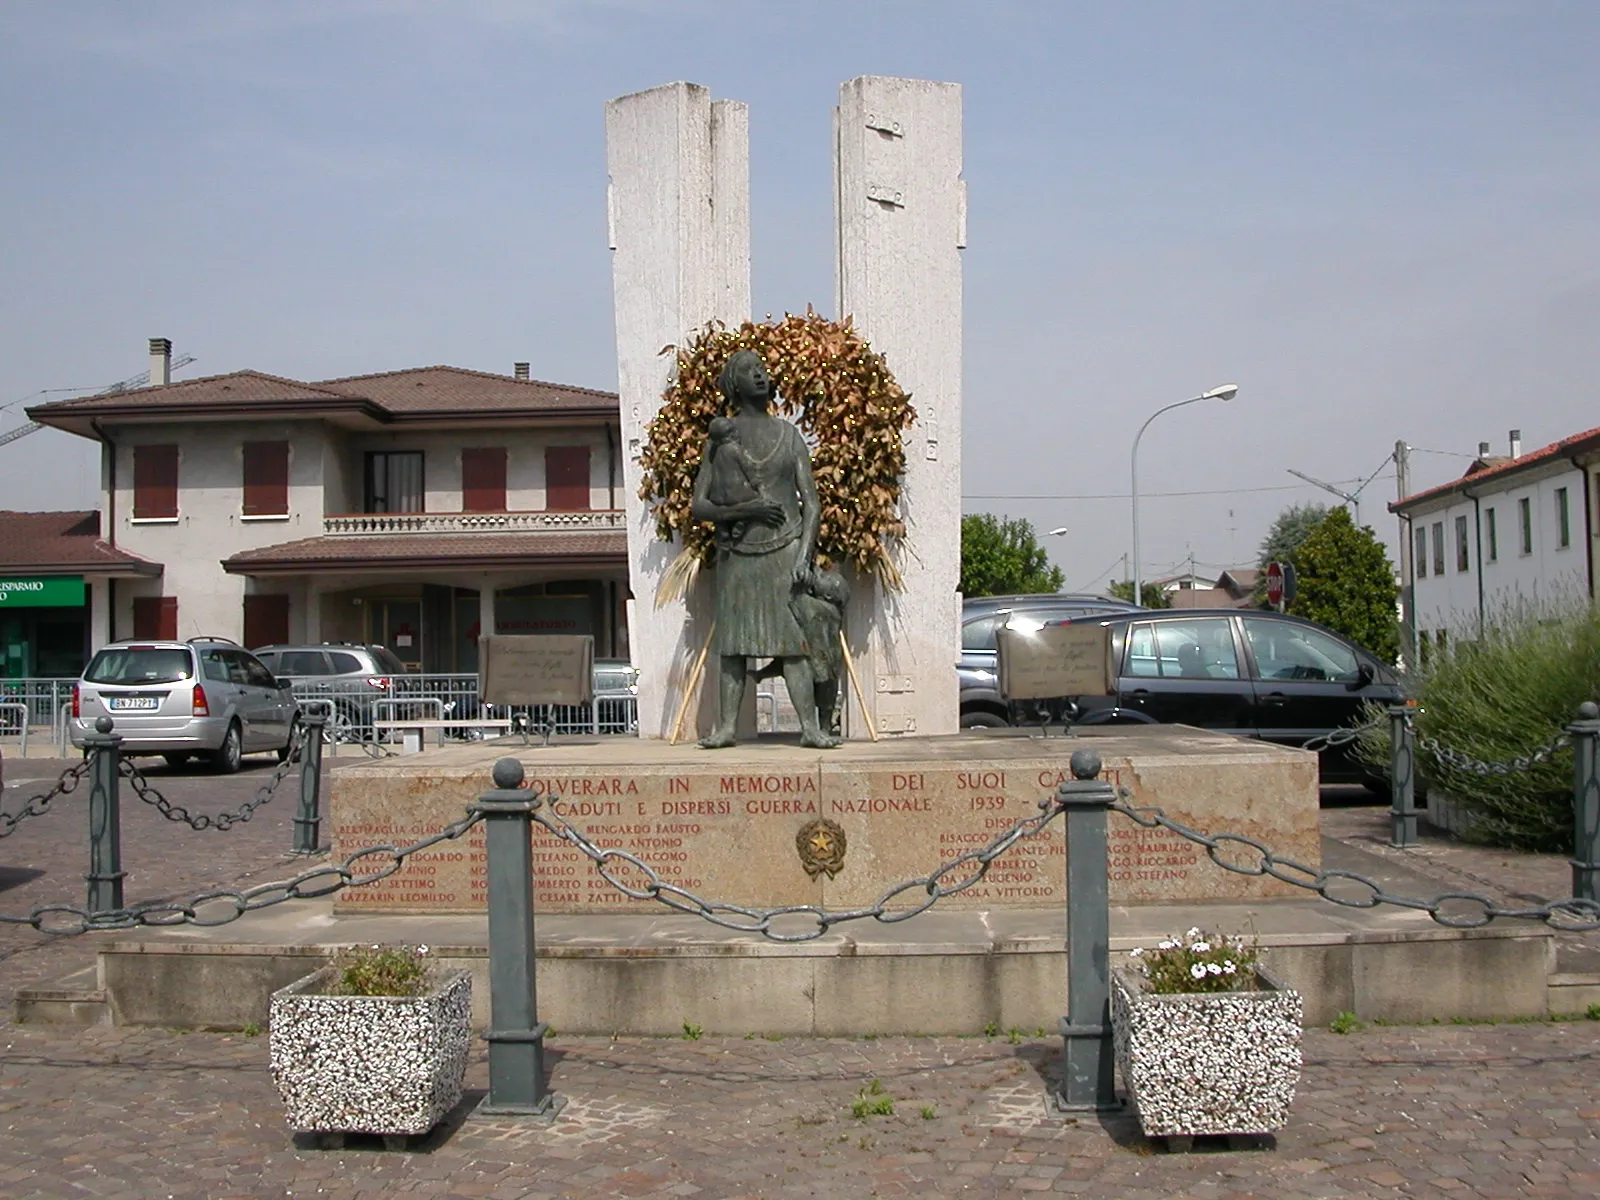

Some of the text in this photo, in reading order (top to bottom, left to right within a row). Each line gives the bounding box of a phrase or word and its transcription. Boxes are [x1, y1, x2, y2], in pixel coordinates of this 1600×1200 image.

[669, 777, 690, 794] IN
[720, 776, 816, 794] MEMORIA
[893, 774, 924, 791] DEI
[957, 772, 1006, 790] SUOI
[1038, 769, 1120, 789] CATI
[555, 802, 621, 816] CADUTI
[638, 802, 645, 815] E
[662, 801, 730, 815] DISPERSI
[746, 800, 816, 814] GUERRA
[832, 798, 932, 813] NAZIONALE
[971, 796, 1005, 811] 1939
[586, 824, 701, 834] MENGARDO FAUSTO
[629, 838, 682, 848] ANTONIO
[939, 833, 989, 843] BISACCO
[1008, 846, 1044, 856] SANTE
[1136, 843, 1193, 853] MAURIZIO
[409, 853, 464, 862] EDOARDO
[533, 853, 578, 862] TEFANO
[1136, 856, 1197, 866] RICCARDO
[1136, 870, 1188, 880] STEFANO
[390, 879, 436, 889] SETTIMO
[341, 892, 456, 902] LAZZARIN LEOMILDO
[996, 887, 1053, 897] VITTORIO
[539, 893, 580, 903] CESARE
[588, 893, 621, 903] ZATTI
